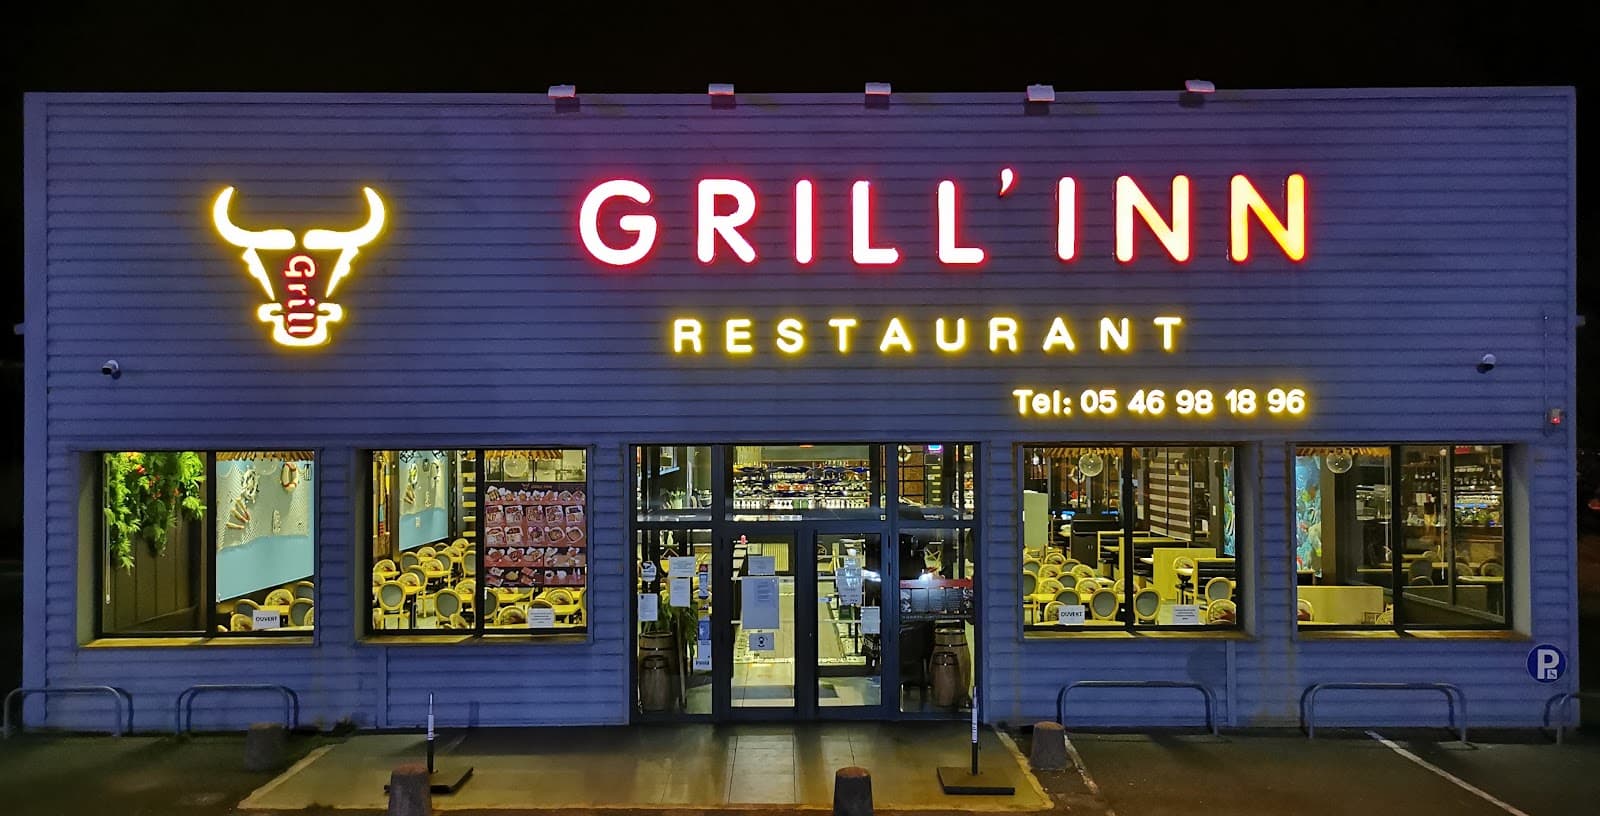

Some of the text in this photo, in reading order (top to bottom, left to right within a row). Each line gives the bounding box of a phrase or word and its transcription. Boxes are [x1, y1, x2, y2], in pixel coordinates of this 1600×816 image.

[284, 254, 316, 334] Grill
[673, 316, 1183, 354] RESTAURANT
[1012, 389, 1305, 416] Tel: 05 46 98 18 96
